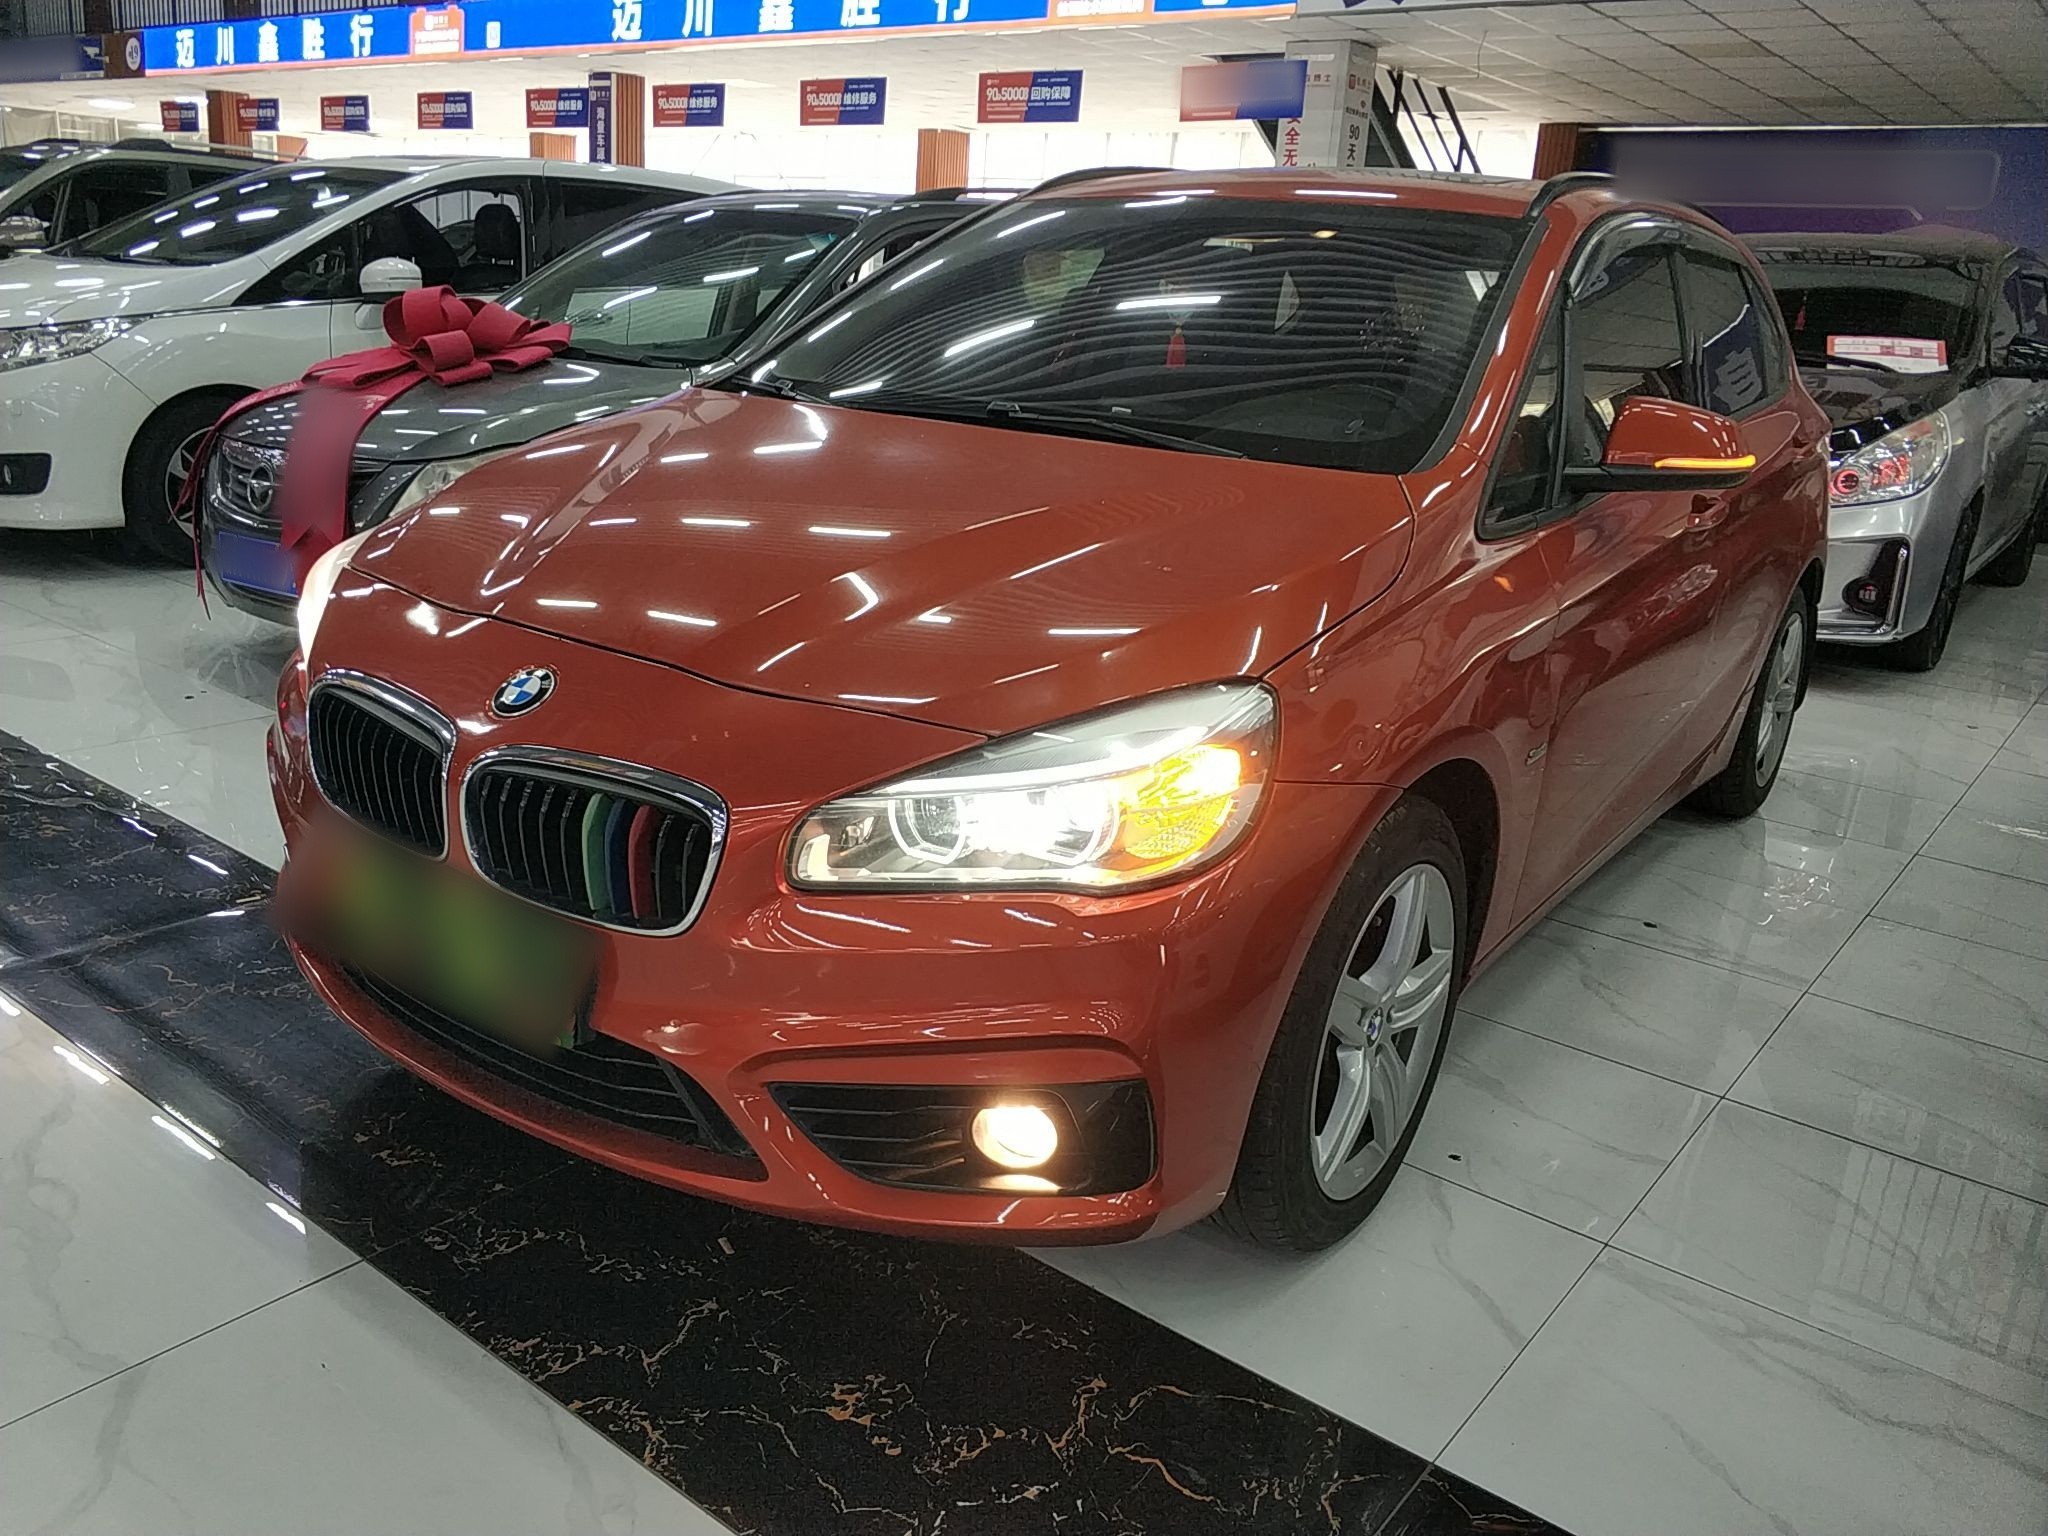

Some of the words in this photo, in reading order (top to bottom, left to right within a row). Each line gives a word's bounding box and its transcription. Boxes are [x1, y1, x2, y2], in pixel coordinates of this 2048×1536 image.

[175, 14, 374, 68] 迈川鑫胜行
[1346, 124, 1360, 167] 90天
